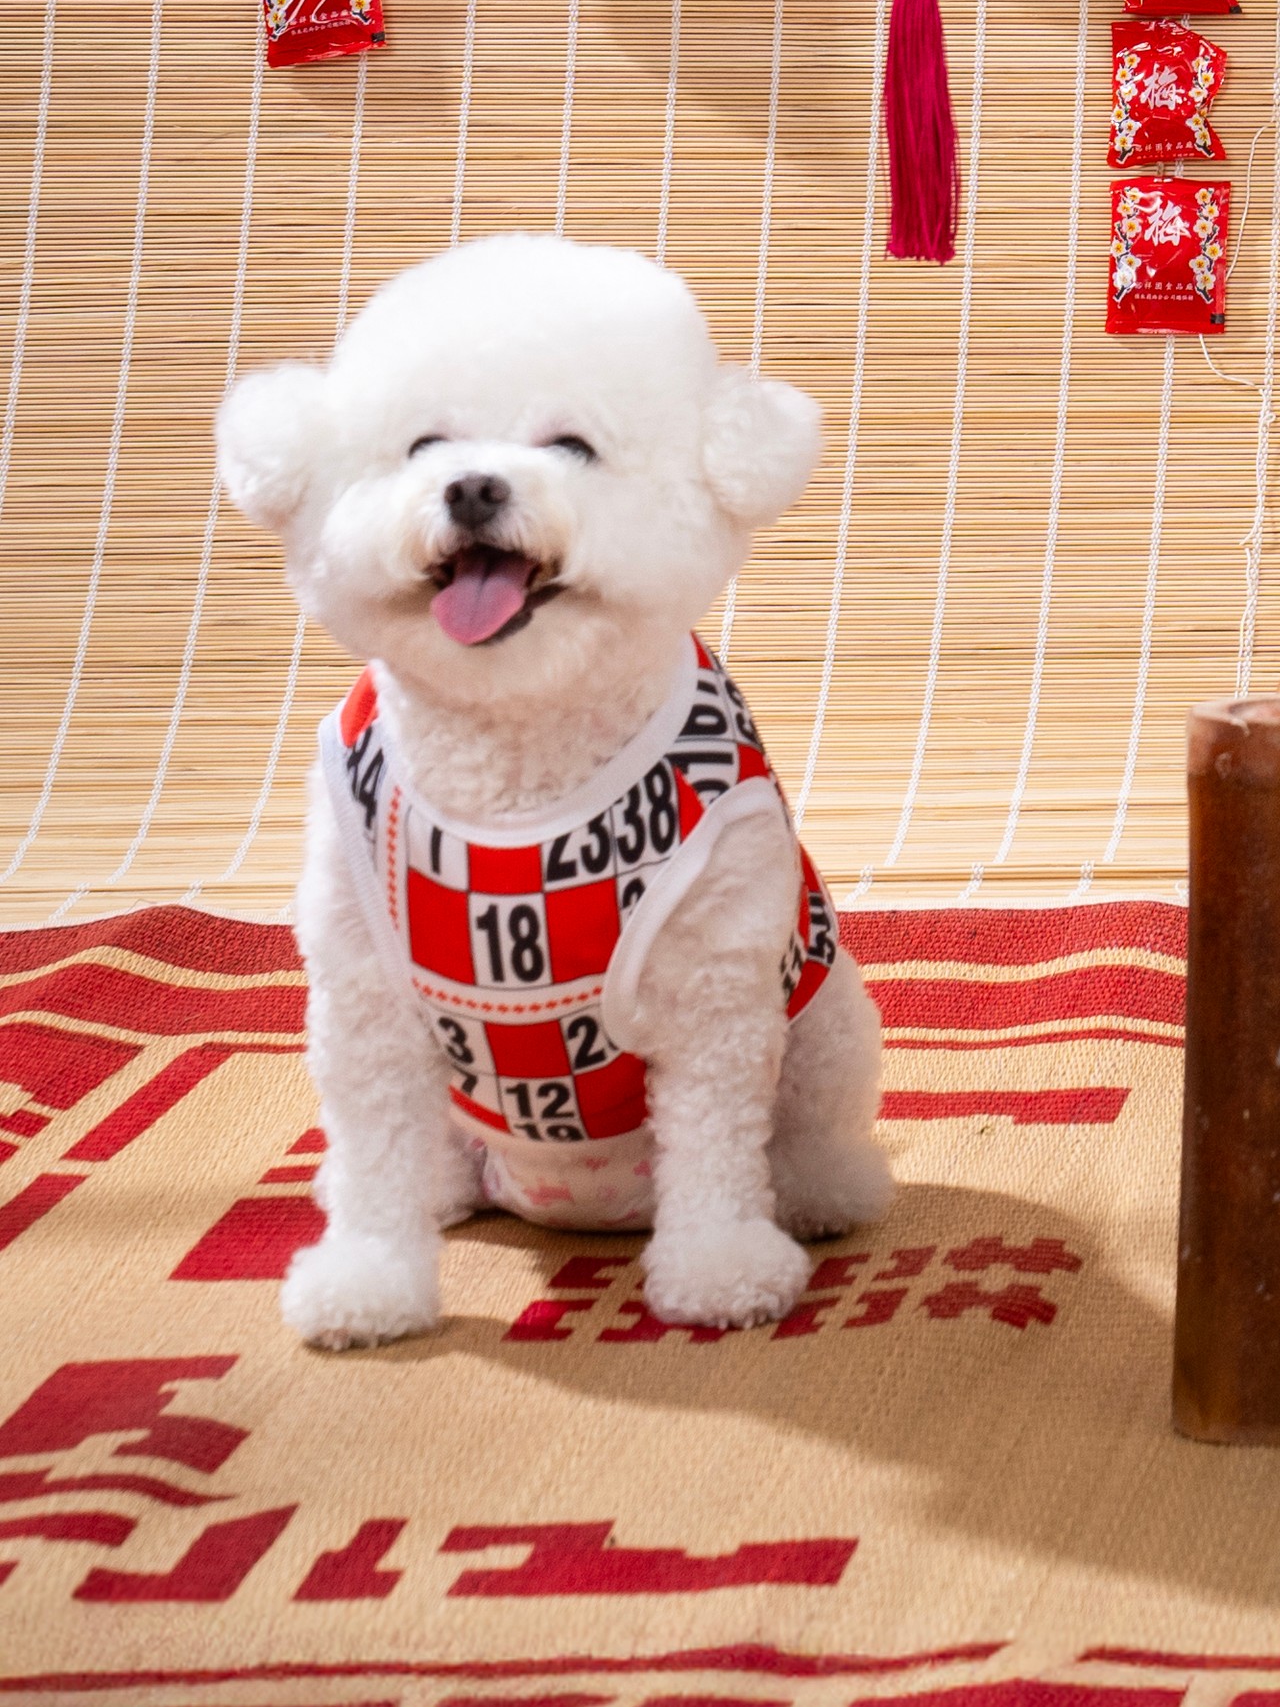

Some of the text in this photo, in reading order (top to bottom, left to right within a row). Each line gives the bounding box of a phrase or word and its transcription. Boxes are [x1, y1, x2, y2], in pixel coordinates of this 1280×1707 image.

[1144, 197, 1191, 246] 梅
[475, 903, 544, 983] 18
[505, 1082, 575, 1119] 12
